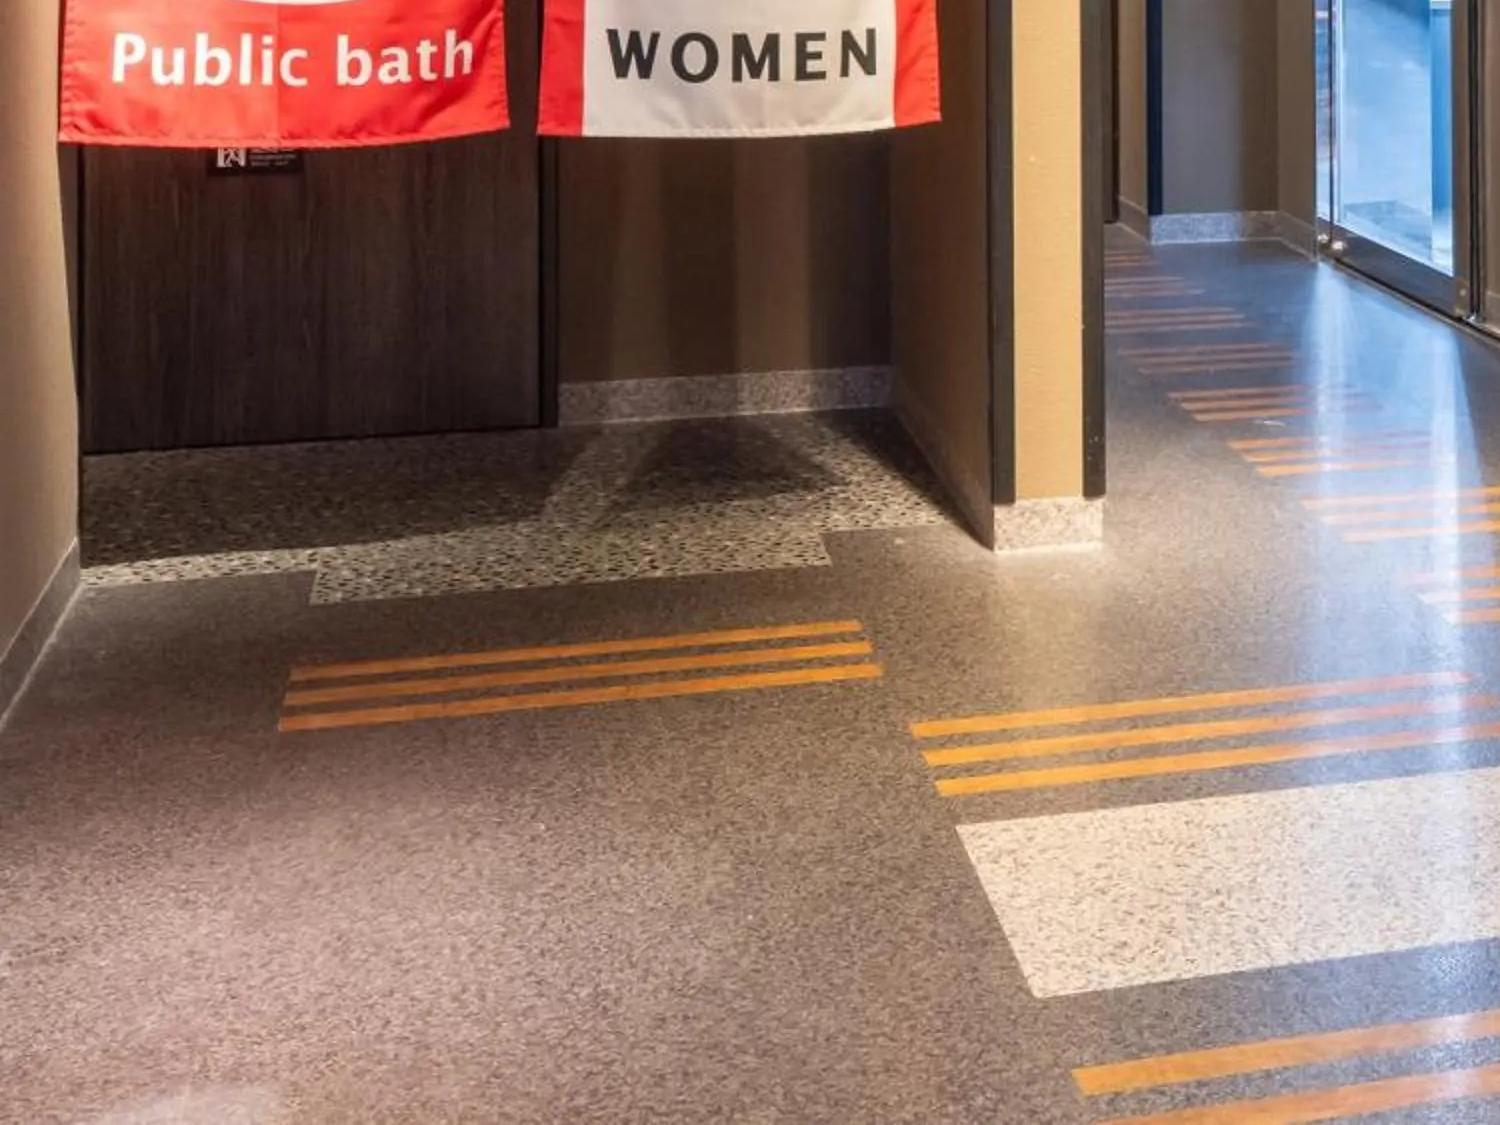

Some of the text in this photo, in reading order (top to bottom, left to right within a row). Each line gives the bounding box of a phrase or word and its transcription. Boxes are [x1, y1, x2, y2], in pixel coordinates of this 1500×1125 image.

[111, 29, 475, 88] Public bath
[606, 27, 878, 84] WOMEN
